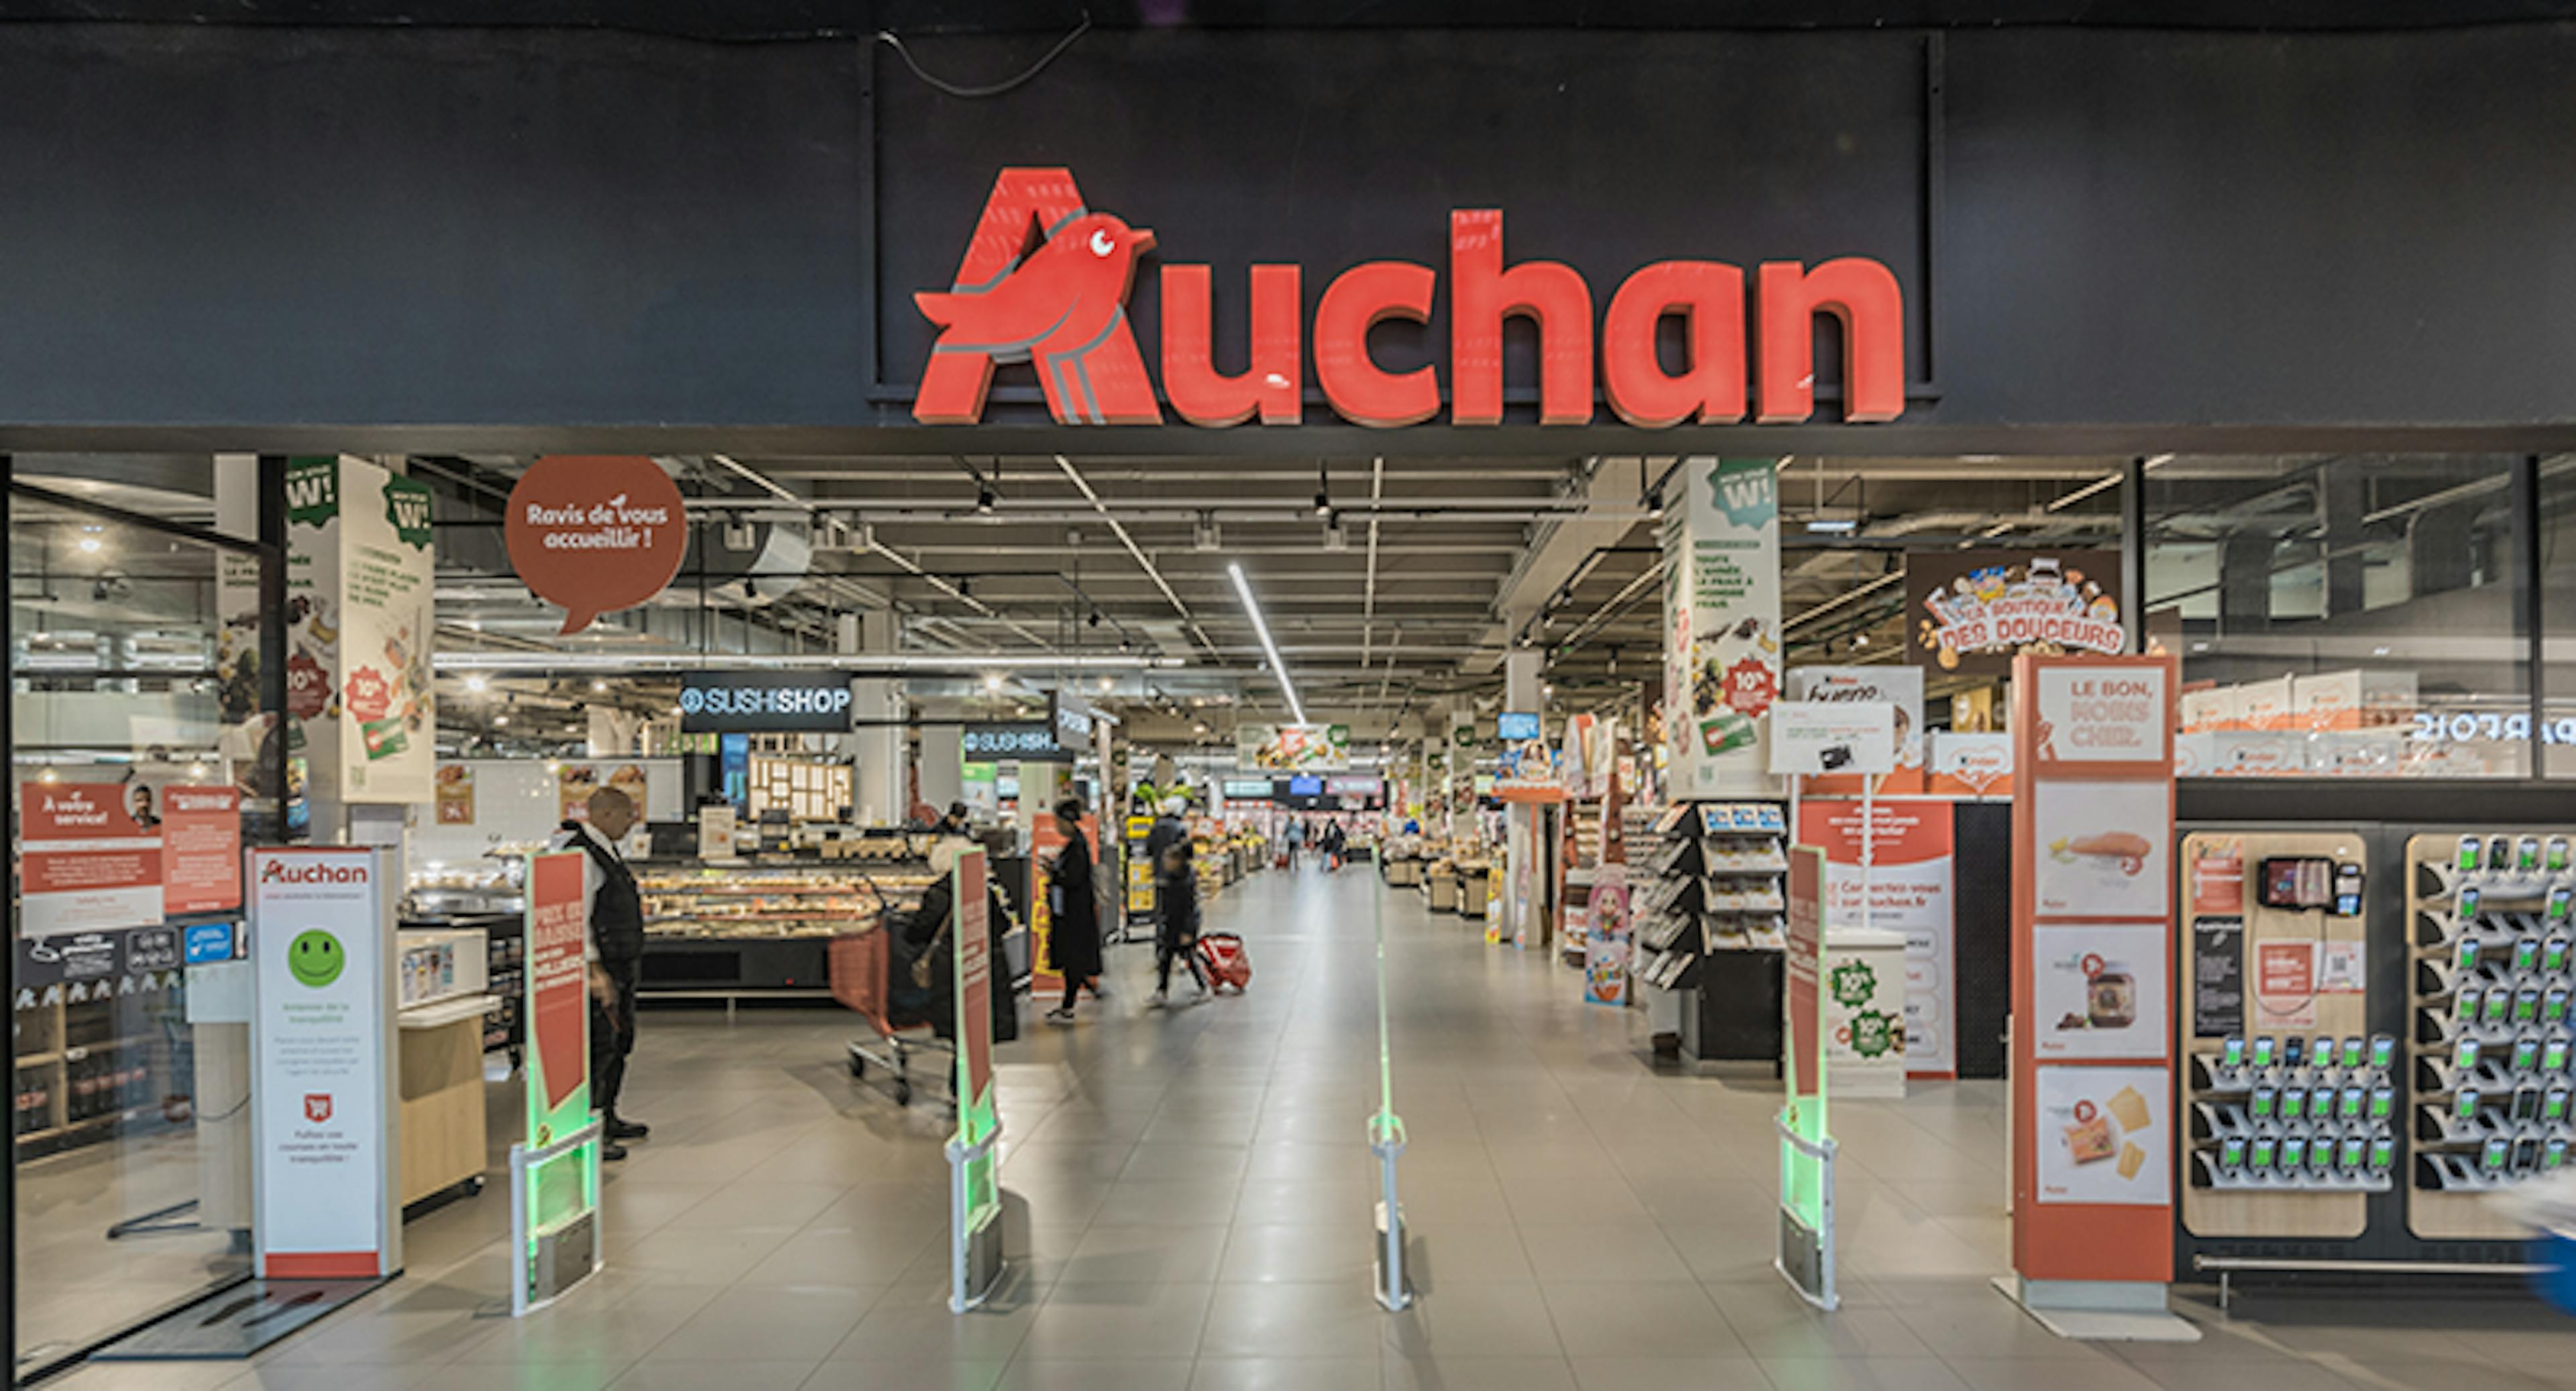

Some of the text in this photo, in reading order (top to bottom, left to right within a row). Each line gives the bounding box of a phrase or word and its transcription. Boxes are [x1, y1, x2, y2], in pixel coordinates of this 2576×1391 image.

[915, 168, 1904, 427] Auchan
[527, 503, 668, 524] Ravis de vous
[543, 526, 653, 548] accueillir !
[1991, 598, 2065, 616] BOUTIQUE
[1943, 618, 2122, 650] DES DOUCEURS
[2071, 680, 2153, 699] LE BON,
[57, 800, 95, 812] votre
[262, 859, 367, 883] Auchan
